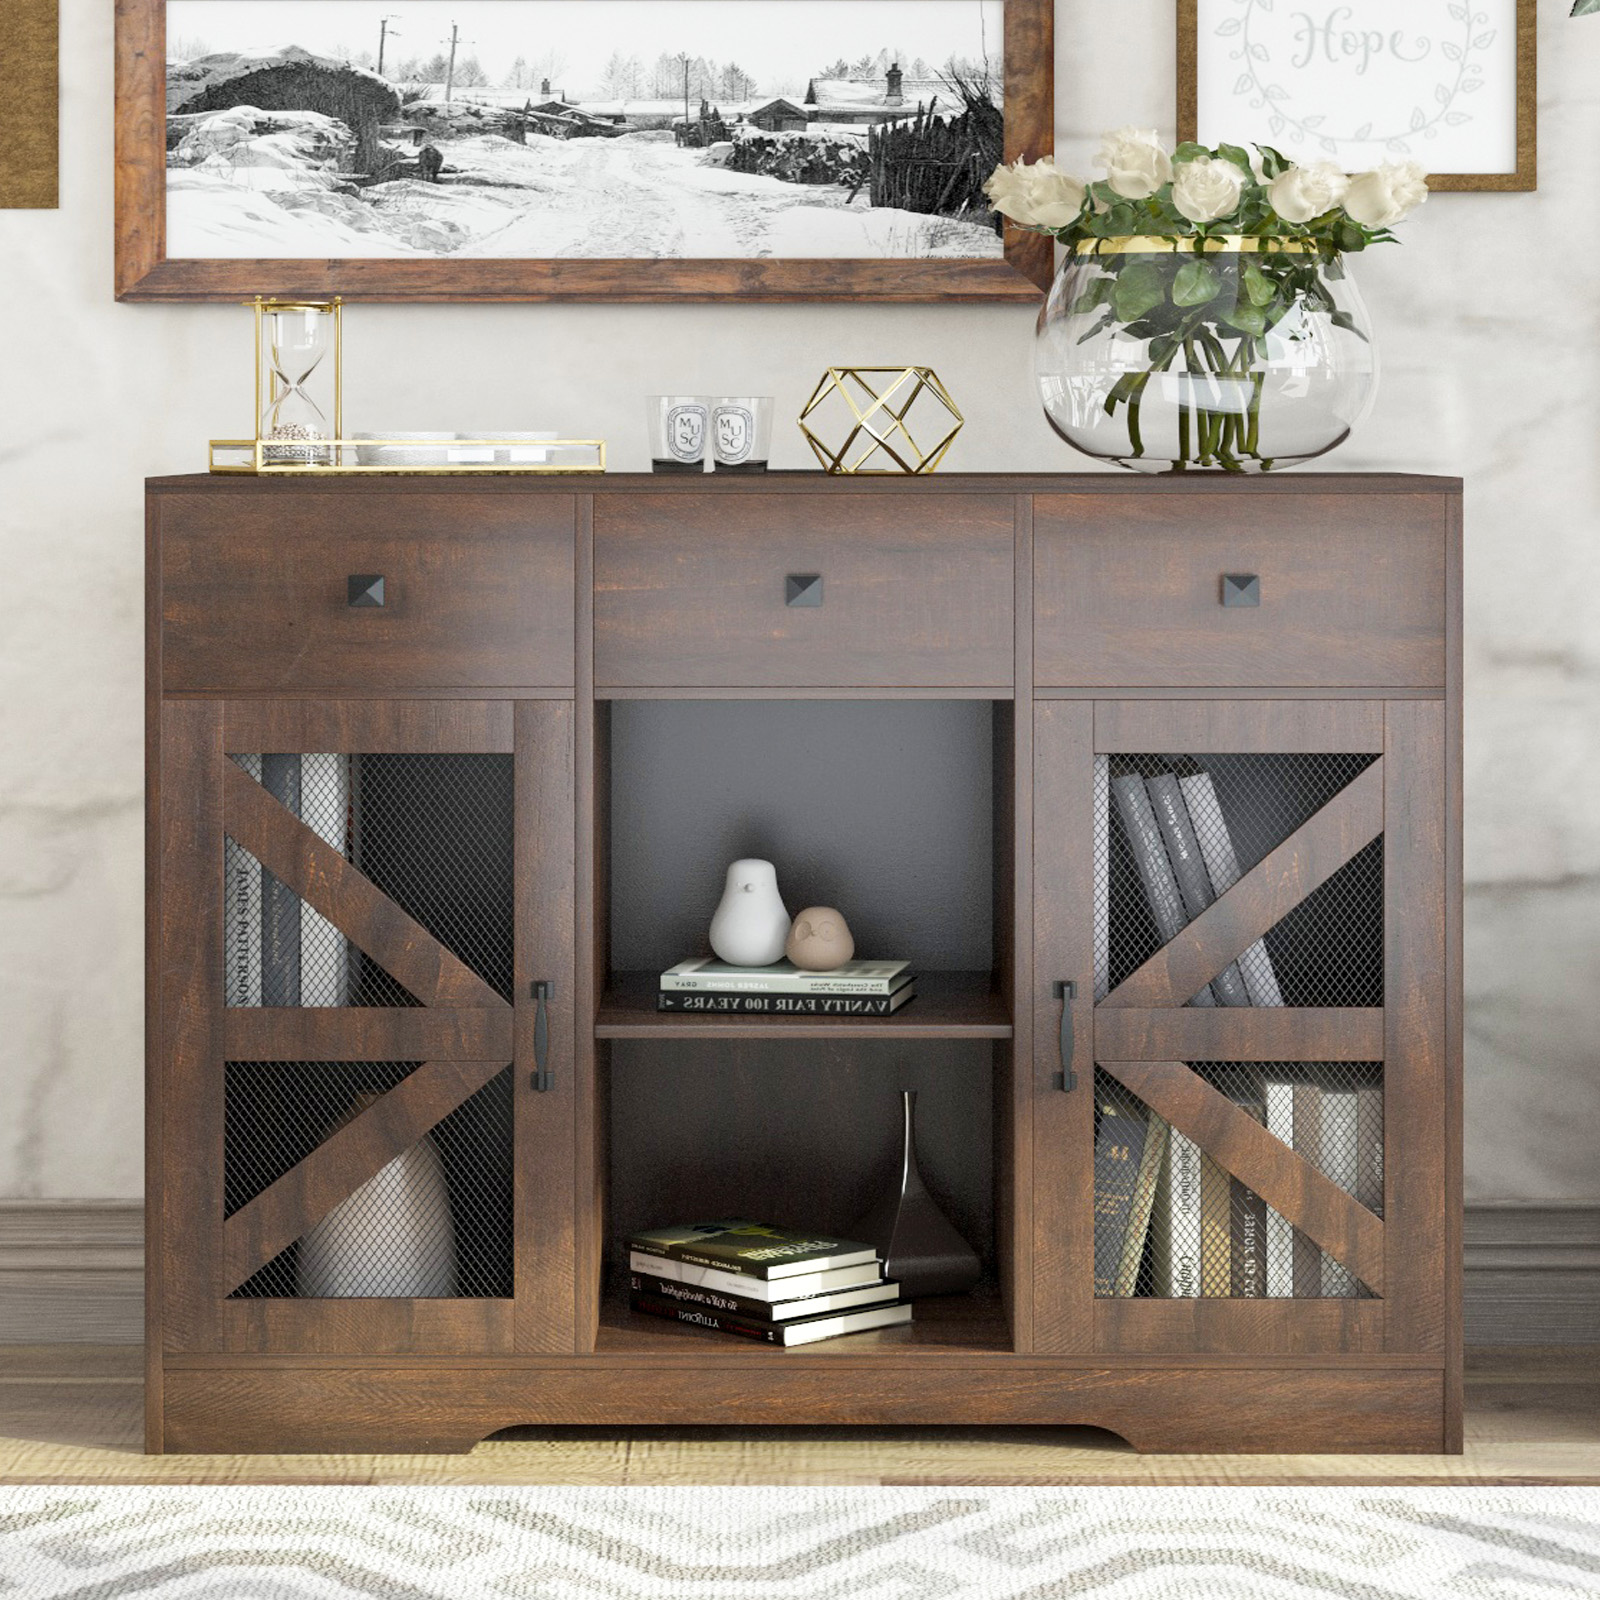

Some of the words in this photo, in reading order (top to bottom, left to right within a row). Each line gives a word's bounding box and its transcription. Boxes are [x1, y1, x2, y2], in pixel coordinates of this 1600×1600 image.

[1290, 6, 1431, 76] Hope
[237, 868, 249, 915] JAMES
[237, 921, 249, 1005] PATTERSON
